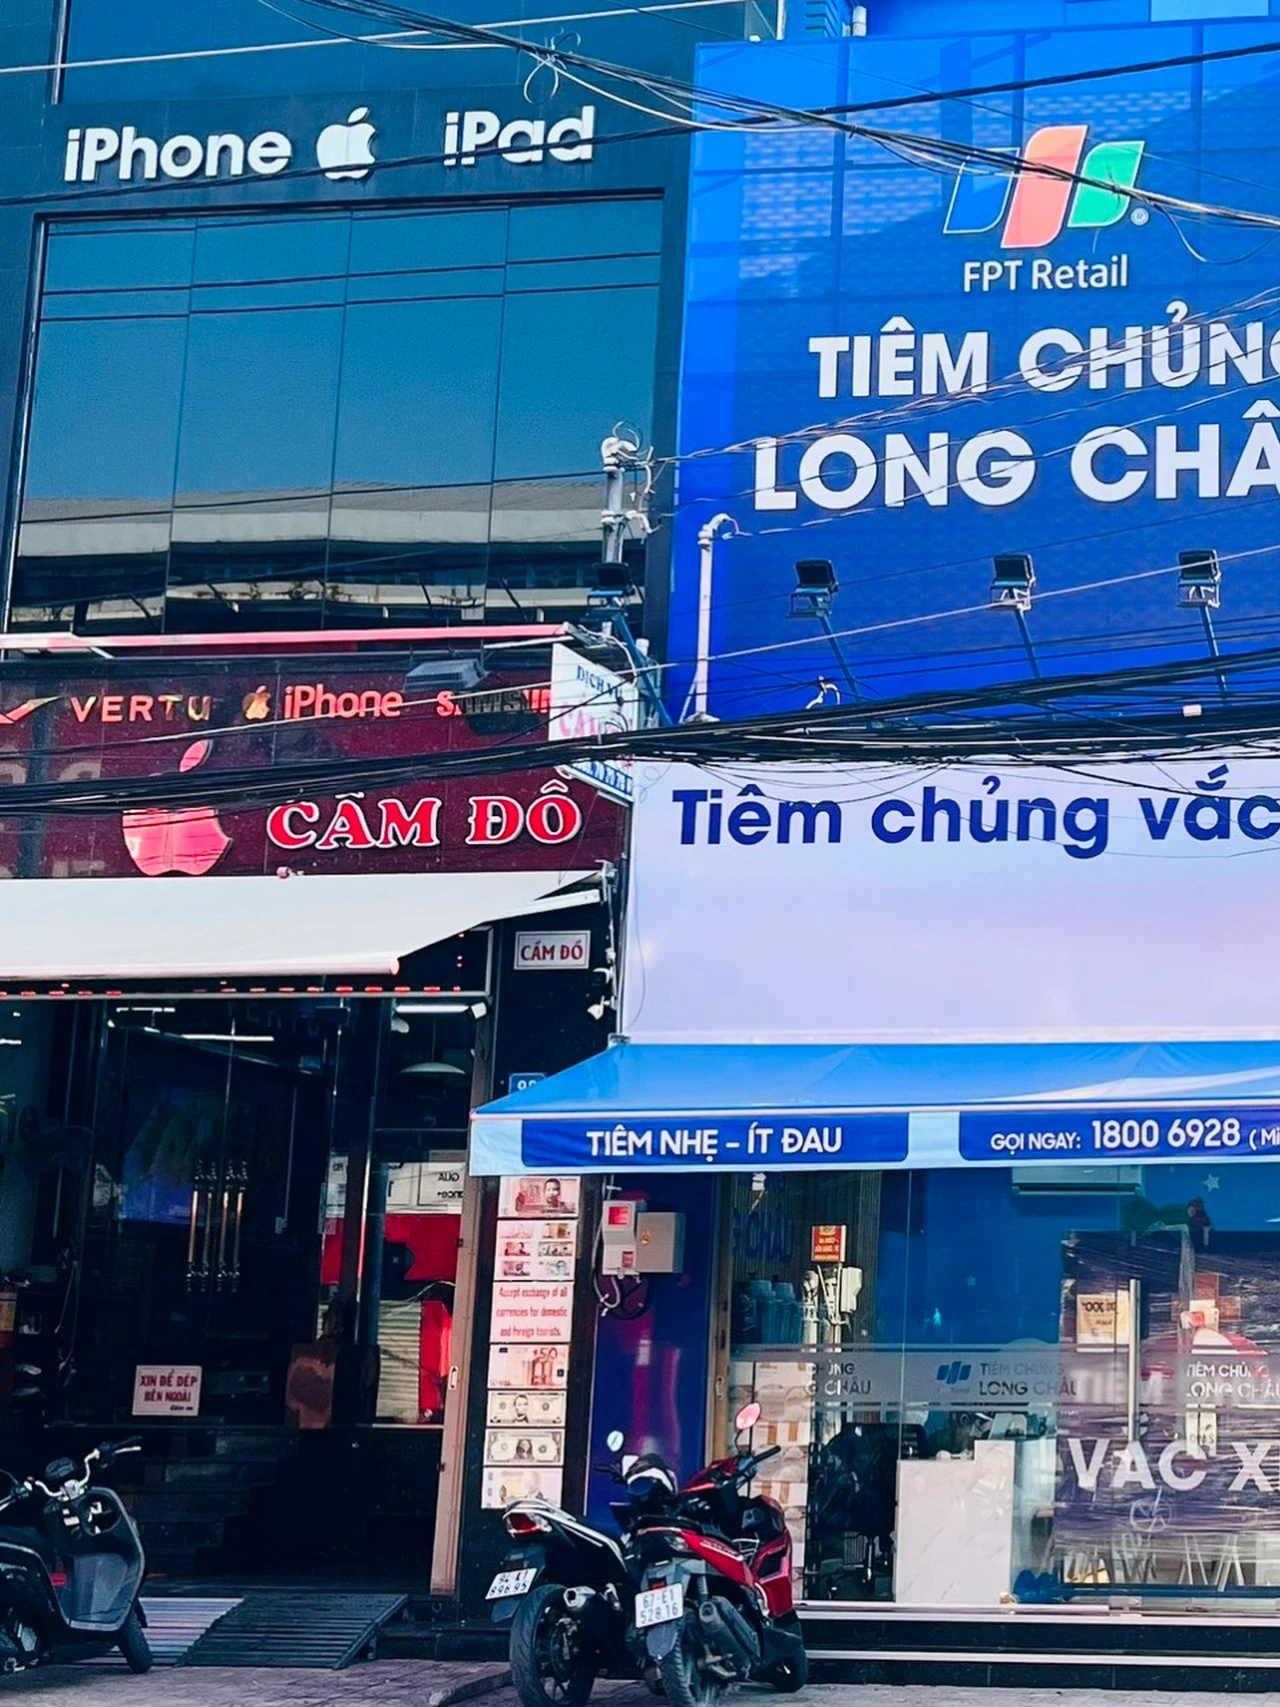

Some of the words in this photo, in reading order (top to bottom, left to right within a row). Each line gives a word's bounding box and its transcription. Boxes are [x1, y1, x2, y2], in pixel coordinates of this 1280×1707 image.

[64, 126, 293, 183] iPhone
[443, 105, 595, 167] iPad
[963, 259, 1023, 292] FPT
[1031, 254, 1128, 291] Retail
[809, 316, 988, 398] TIÊM
[754, 427, 1036, 511] LONG
[70, 695, 212, 723] VERTU
[284, 684, 403, 719] iPhone
[672, 784, 843, 846] Tiêm
[871, 776, 1110, 859] chủng
[586, 1124, 652, 1156] TIÊM
[660, 1128, 719, 1162] NHẸ
[748, 1122, 774, 1154] ÍT
[781, 1126, 843, 1155] ĐAU
[990, 1133, 1027, 1155] GỌI
[1029, 1131, 1081, 1151] NGAY:
[1092, 1119, 1160, 1149] 1800
[1167, 1118, 1241, 1147] 6928
[139, 1375, 157, 1387] XIN
[979, 1381, 1028, 1396] LONG
